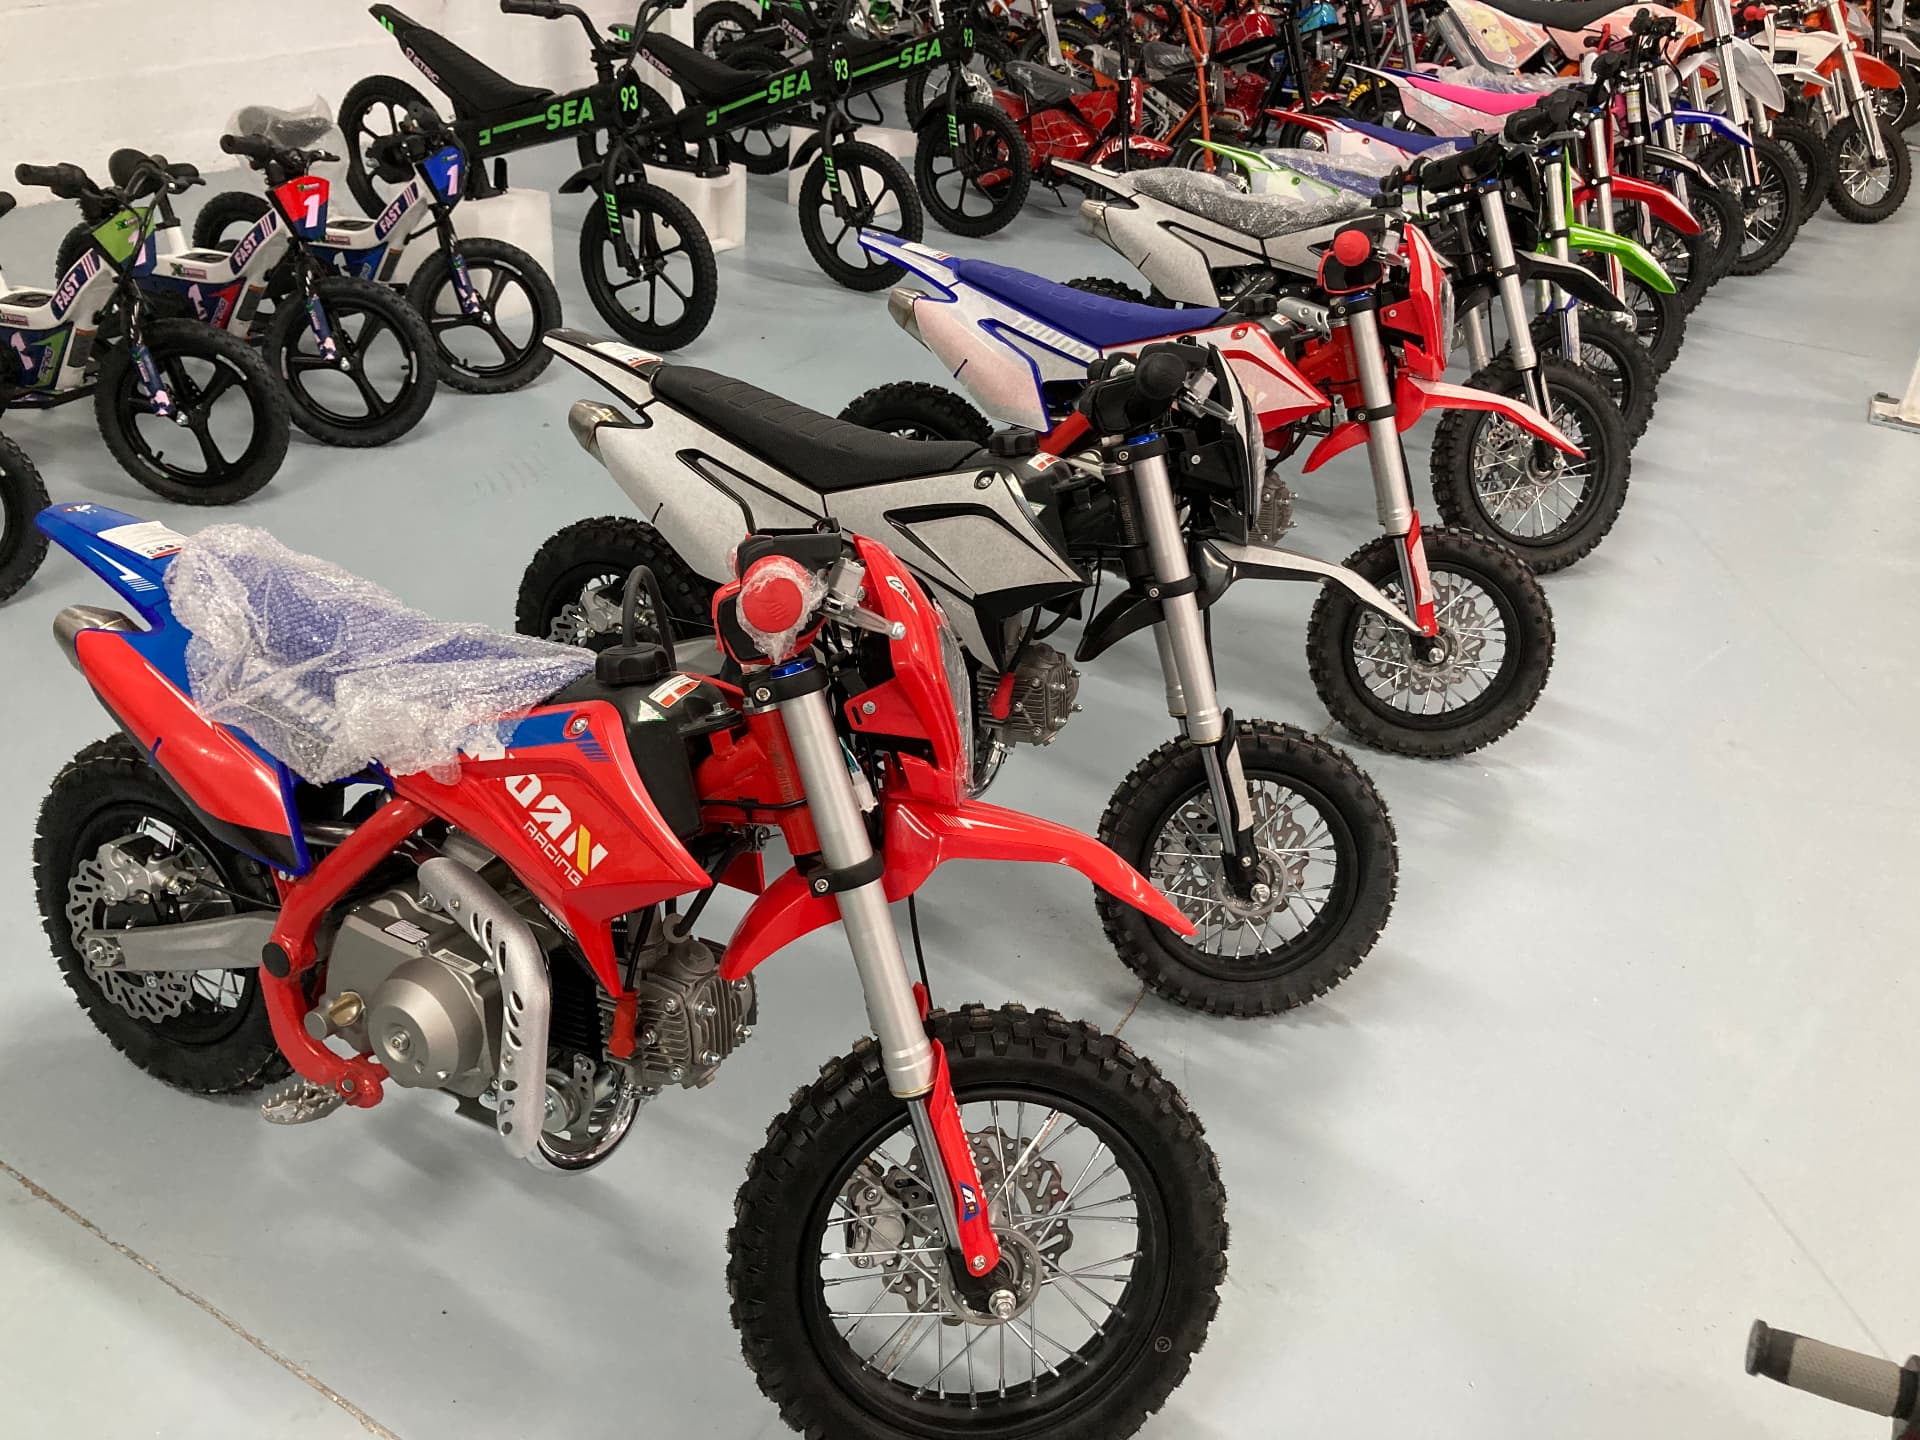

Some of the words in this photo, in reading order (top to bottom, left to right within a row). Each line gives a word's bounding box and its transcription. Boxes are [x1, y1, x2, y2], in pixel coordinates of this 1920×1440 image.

[898, 38, 942, 69] SEA
[963, 28, 973, 48] 93
[834, 58, 849, 81] 93
[620, 85, 639, 112] 93
[767, 70, 812, 104] SEA
[546, 97, 595, 131] SEA
[446, 164, 460, 196] 1
[303, 193, 320, 228] 1
[378, 201, 402, 234] FAST
[233, 231, 259, 267] FAST
[55, 272, 81, 311] FAST
[522, 820, 584, 887] RACING
